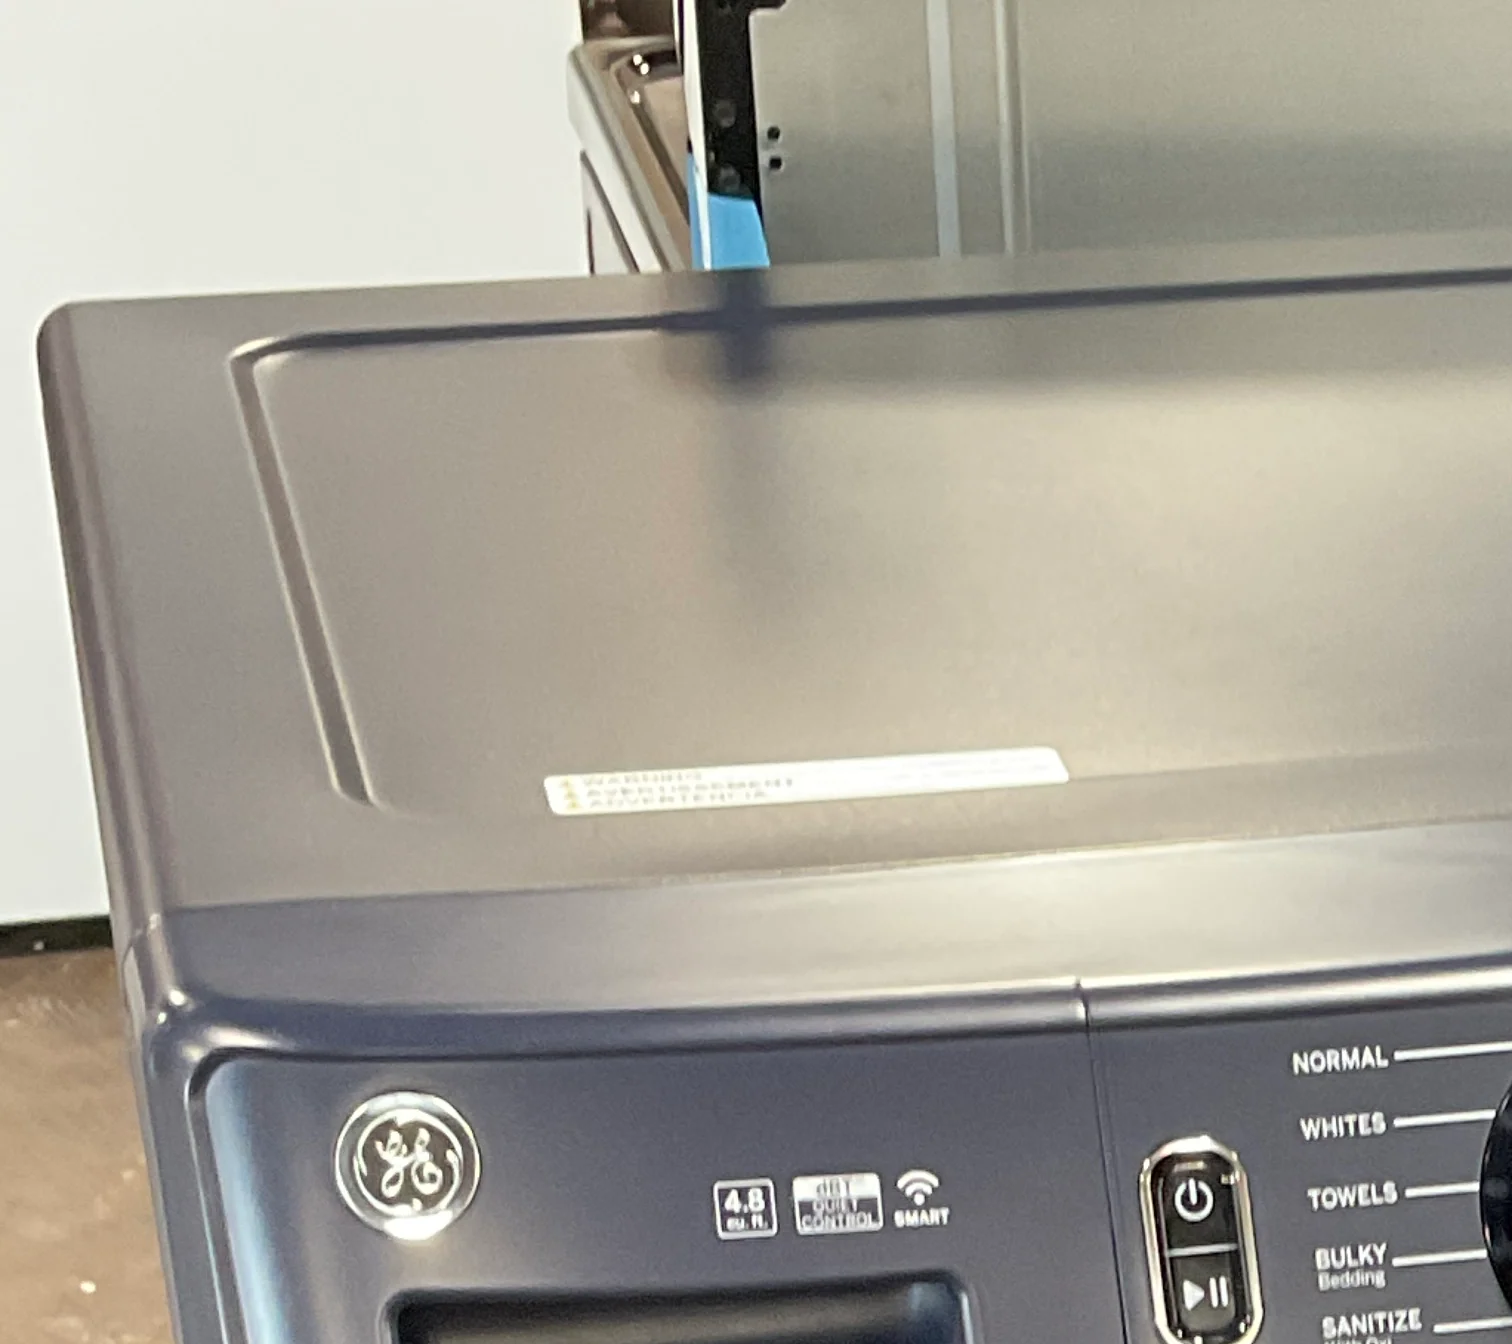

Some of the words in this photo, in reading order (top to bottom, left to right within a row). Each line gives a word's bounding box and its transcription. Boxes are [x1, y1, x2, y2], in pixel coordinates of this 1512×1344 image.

[1291, 1045, 1389, 1076] NORMAL
[1299, 1112, 1387, 1141] WHITES
[723, 1187, 766, 1214] 4.8
[812, 1198, 859, 1214] QUIET
[1307, 1181, 1399, 1211] TOWELS
[801, 1211, 880, 1231] CONTROL
[893, 1207, 950, 1228] SMART
[1314, 1243, 1389, 1271] BULKY
[1317, 1268, 1387, 1292] Bedding
[1321, 1307, 1423, 1340] SANITIZE
